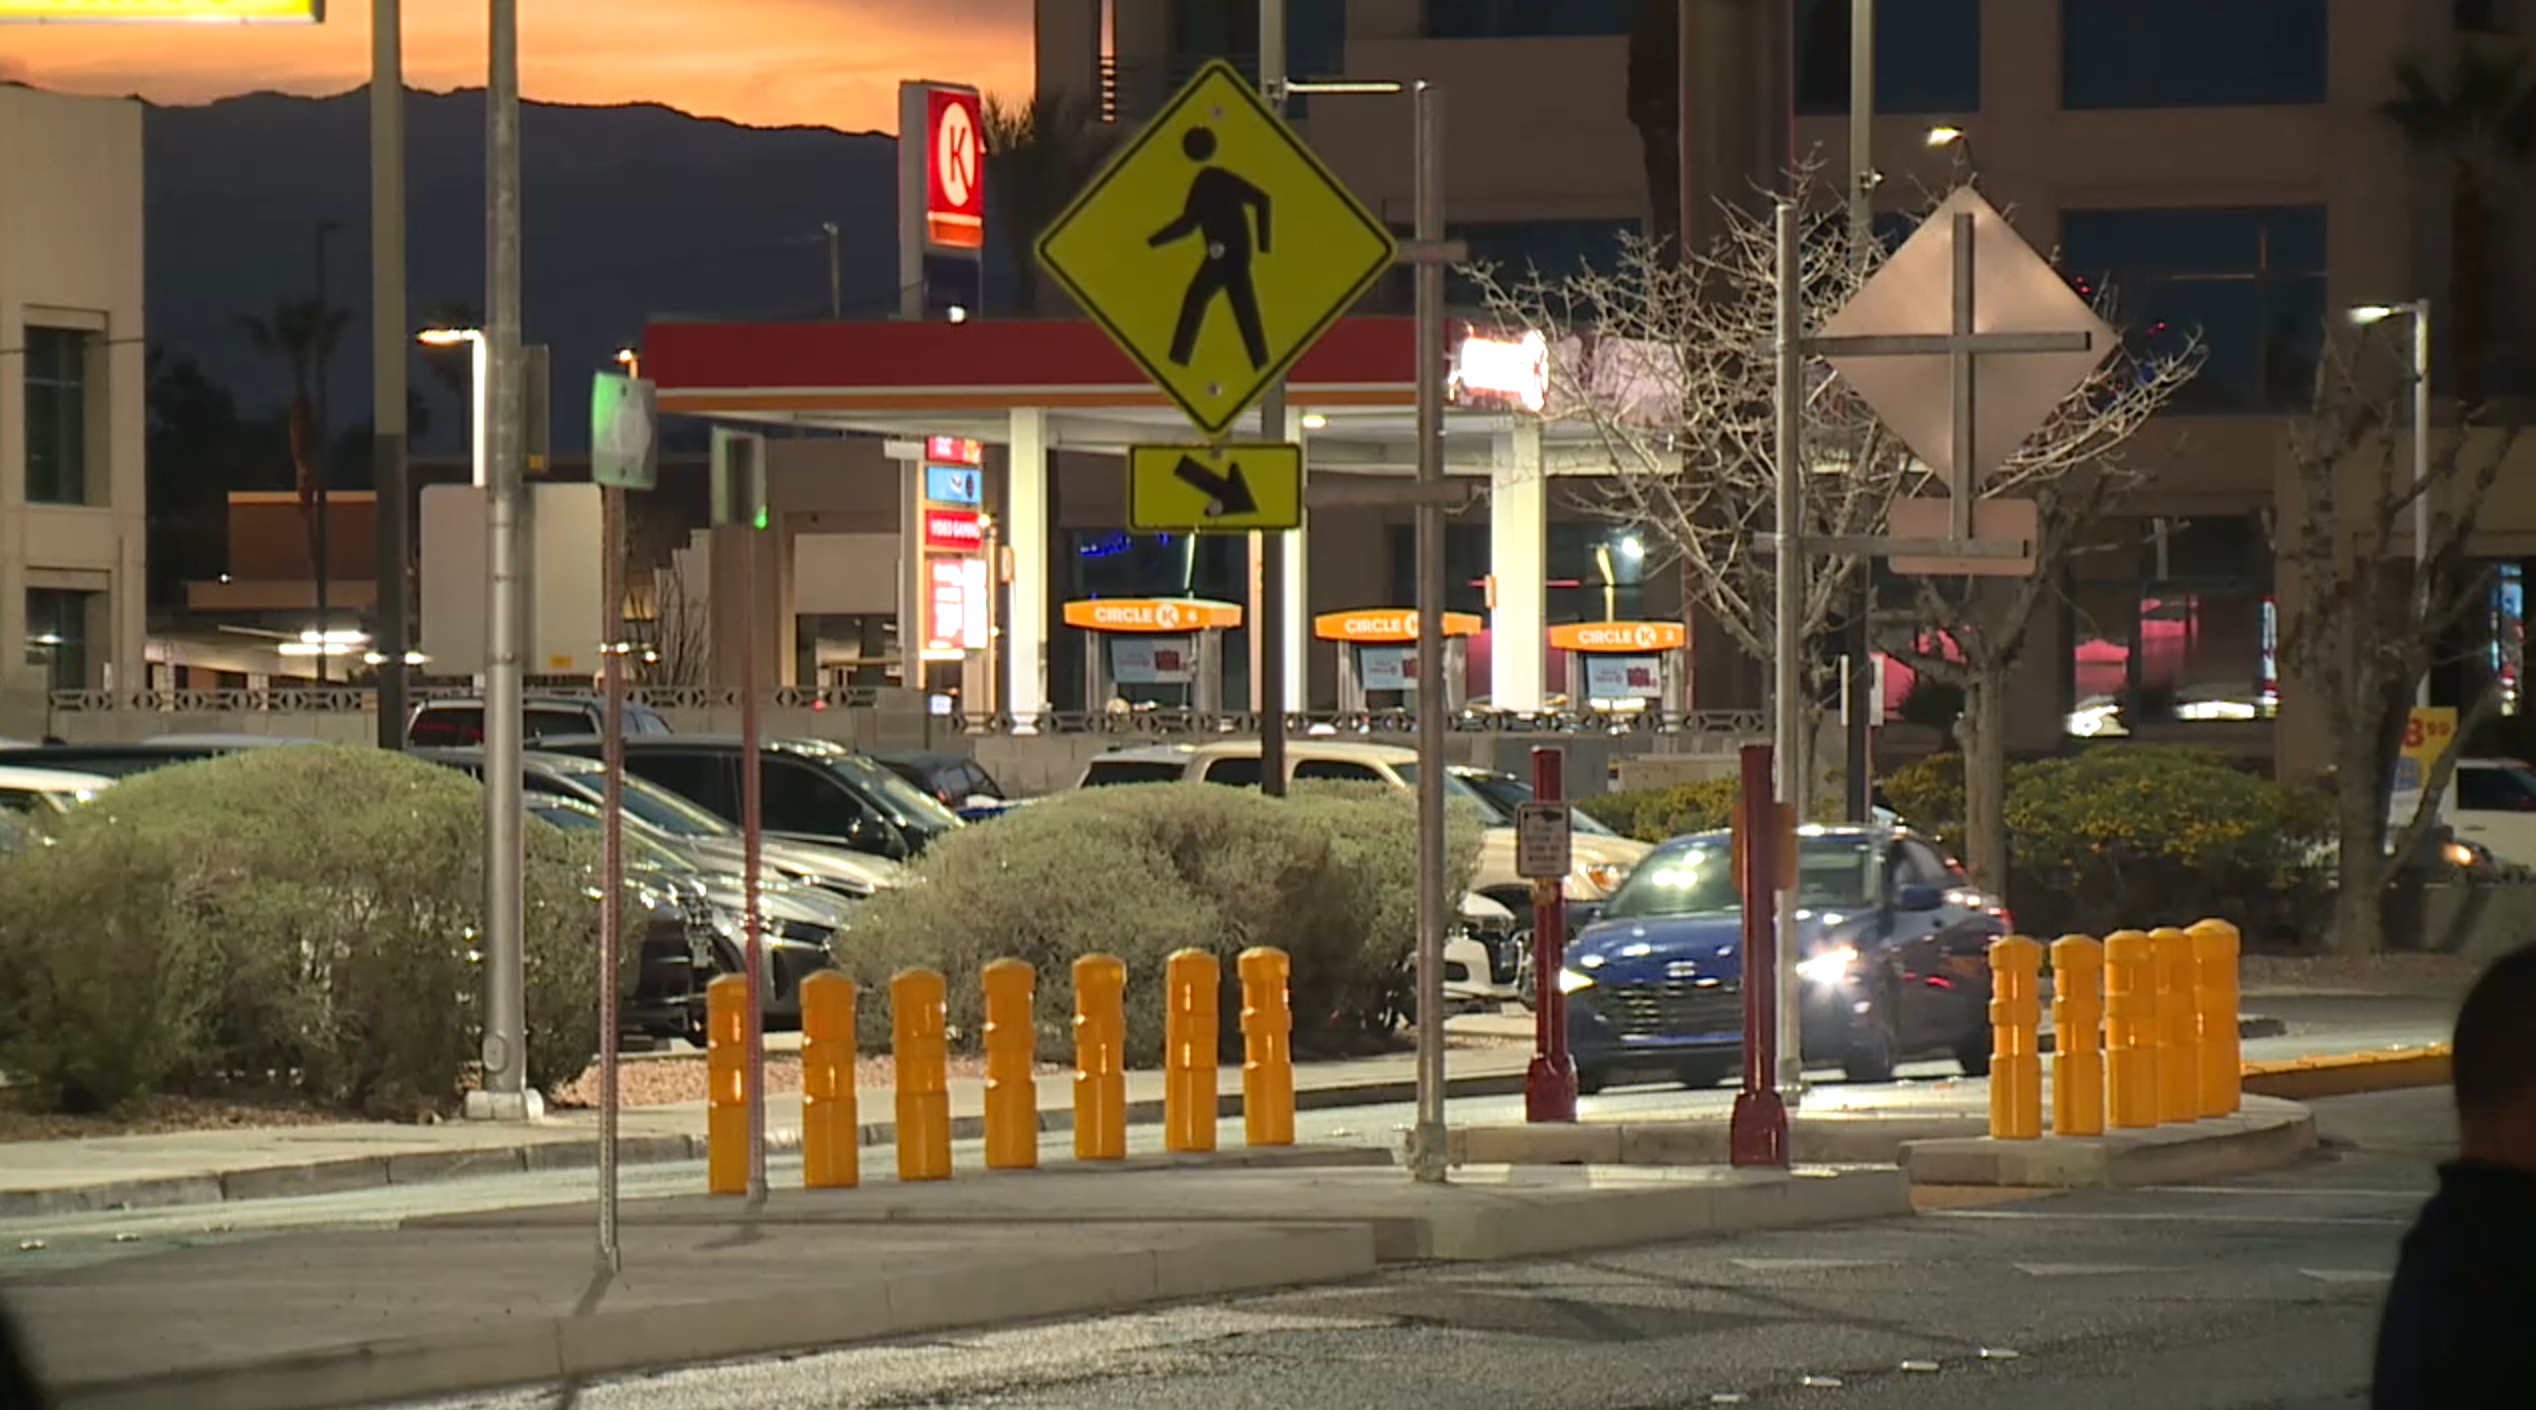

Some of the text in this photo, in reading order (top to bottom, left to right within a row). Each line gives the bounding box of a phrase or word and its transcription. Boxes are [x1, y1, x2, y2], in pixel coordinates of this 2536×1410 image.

[944, 115, 975, 204] K
[931, 519, 981, 539] VIDEO GAMING
[1094, 606, 1153, 624] CIRCLE
[1157, 605, 1179, 627] K
[1344, 618, 1401, 633] CIRCLE
[1578, 629, 1633, 645] CIRCLE
[1636, 627, 1656, 648] K
